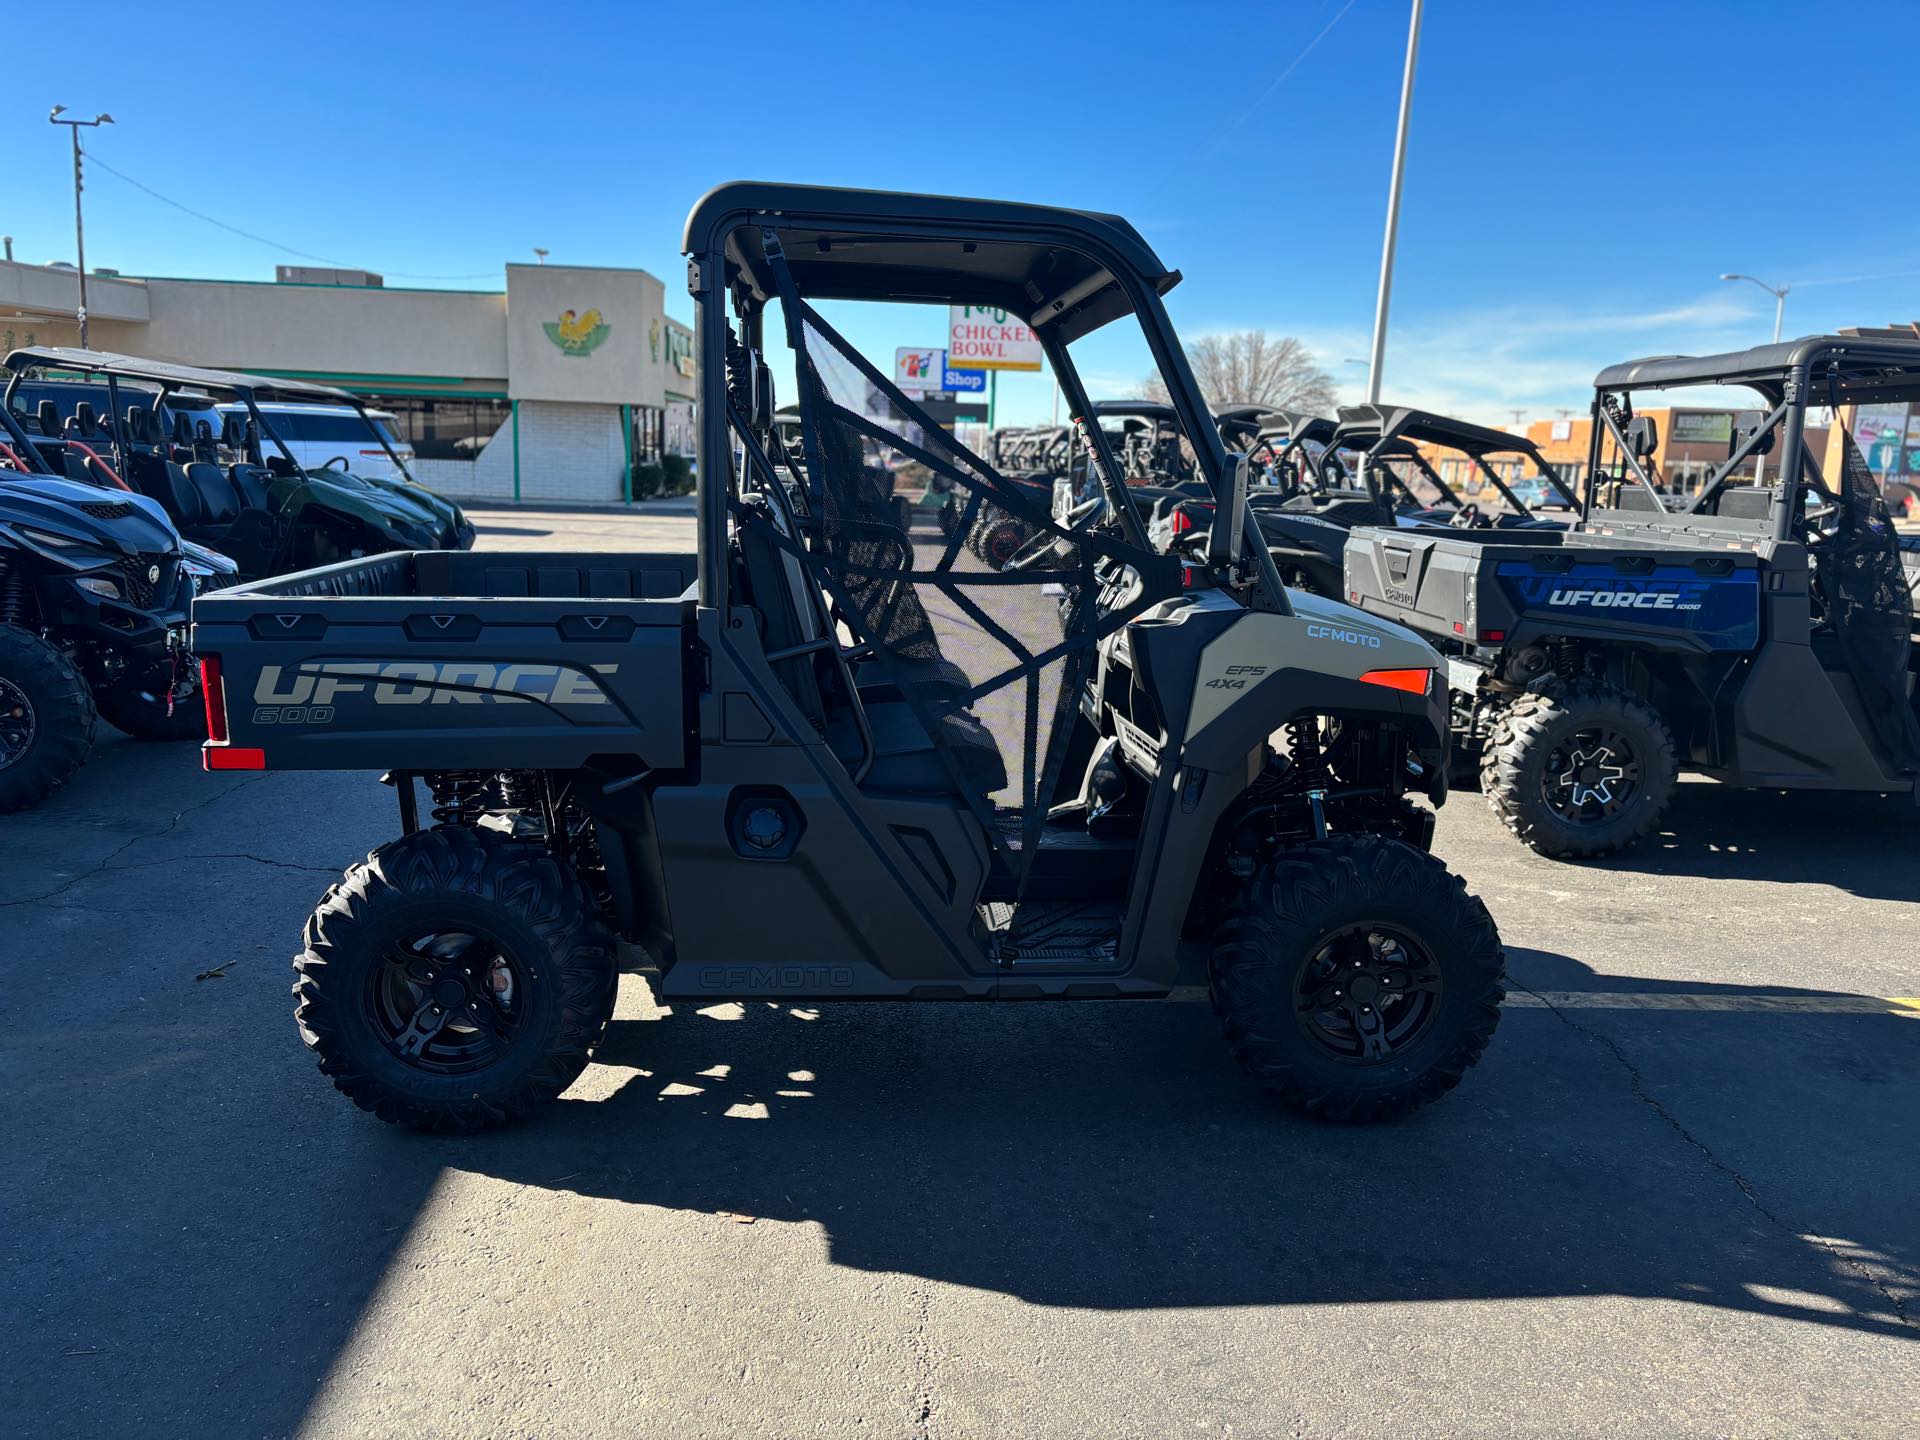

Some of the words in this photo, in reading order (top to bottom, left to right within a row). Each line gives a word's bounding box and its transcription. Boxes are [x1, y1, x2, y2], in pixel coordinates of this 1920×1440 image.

[952, 342, 1007, 357] BOWL
[945, 372, 982, 389] Shop
[1549, 590, 1679, 609] UFORCE
[1307, 625, 1380, 648] CFMOTO
[1225, 665, 1268, 676] EPS
[253, 663, 619, 705] UFORCE
[1205, 679, 1247, 690] 4X4
[251, 706, 336, 725] 600
[700, 967, 855, 988] CFMOTO
